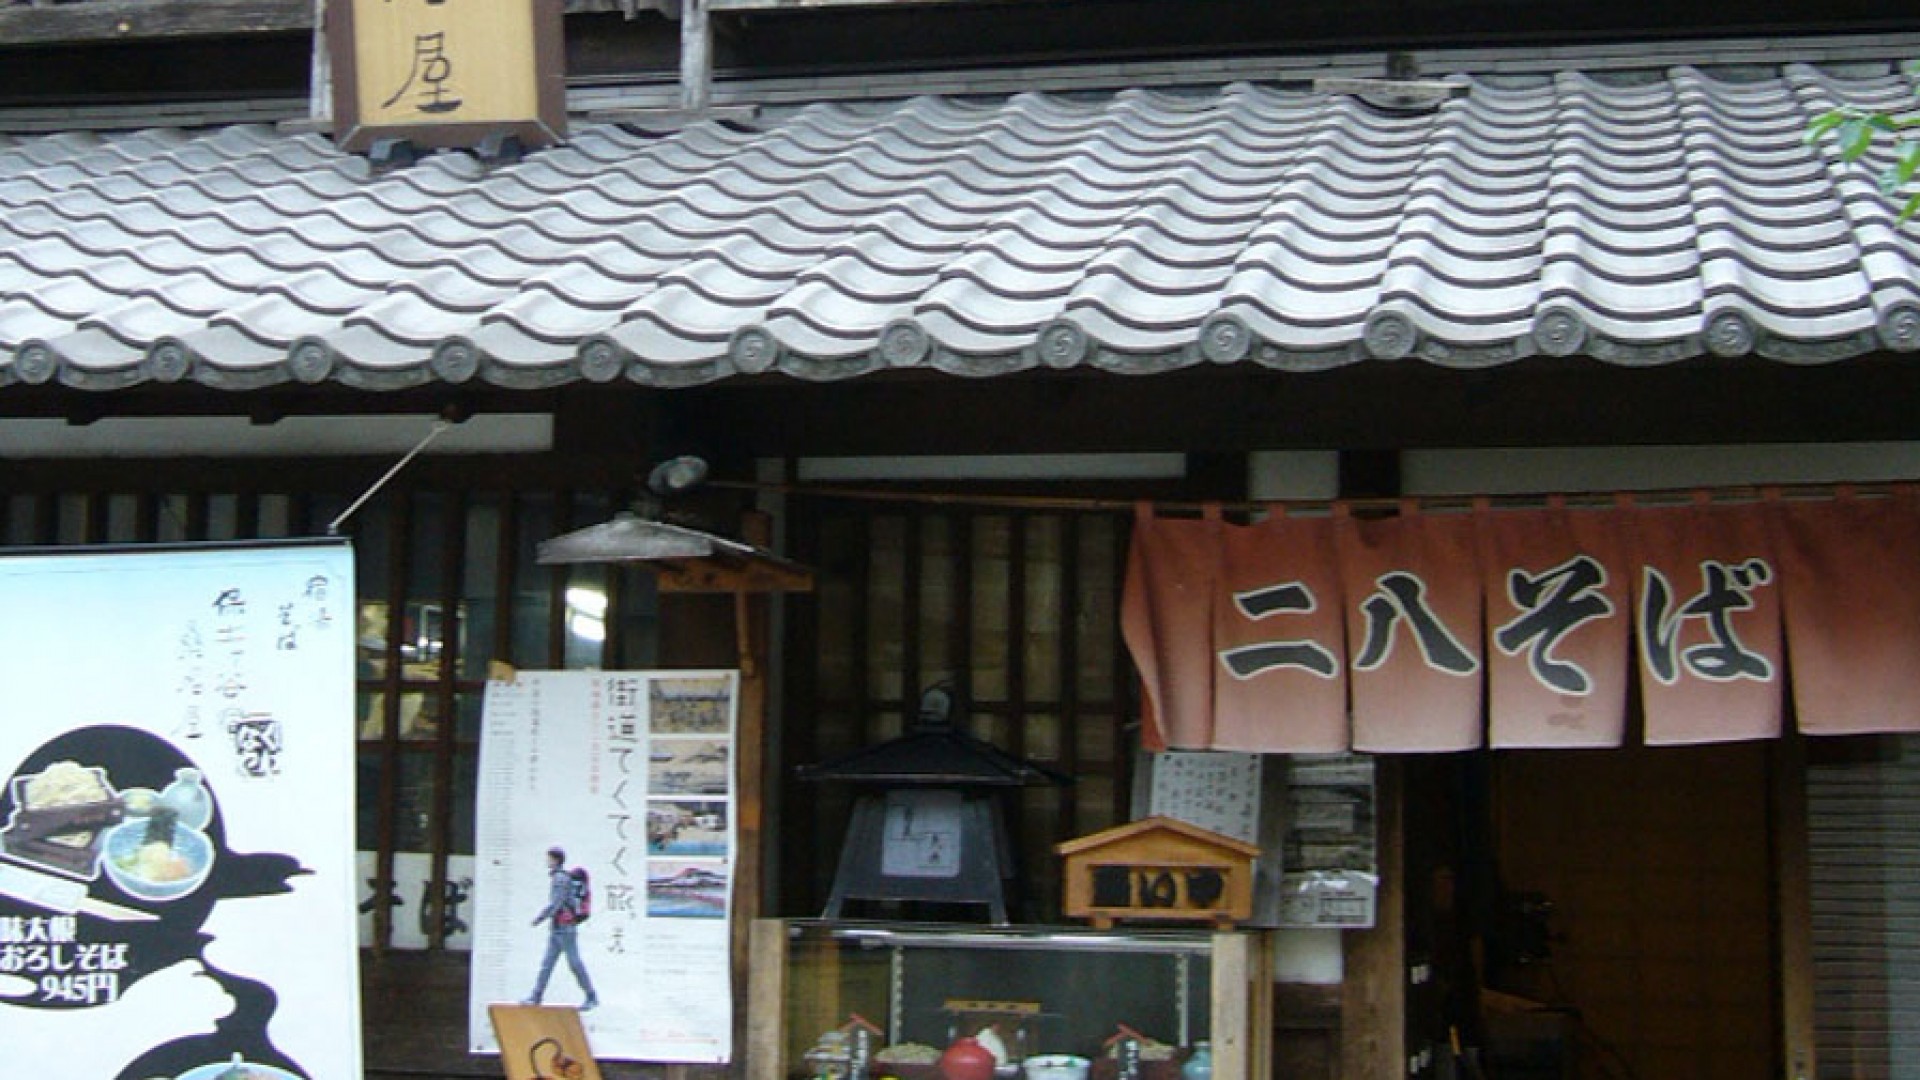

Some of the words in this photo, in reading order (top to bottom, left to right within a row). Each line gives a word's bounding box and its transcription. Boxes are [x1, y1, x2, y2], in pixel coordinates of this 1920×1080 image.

[381, 0, 463, 113] 屋
[1218, 555, 1774, 695] 二八そば
[0, 943, 129, 971] おろしそば
[40, 973, 121, 1003] 945円
